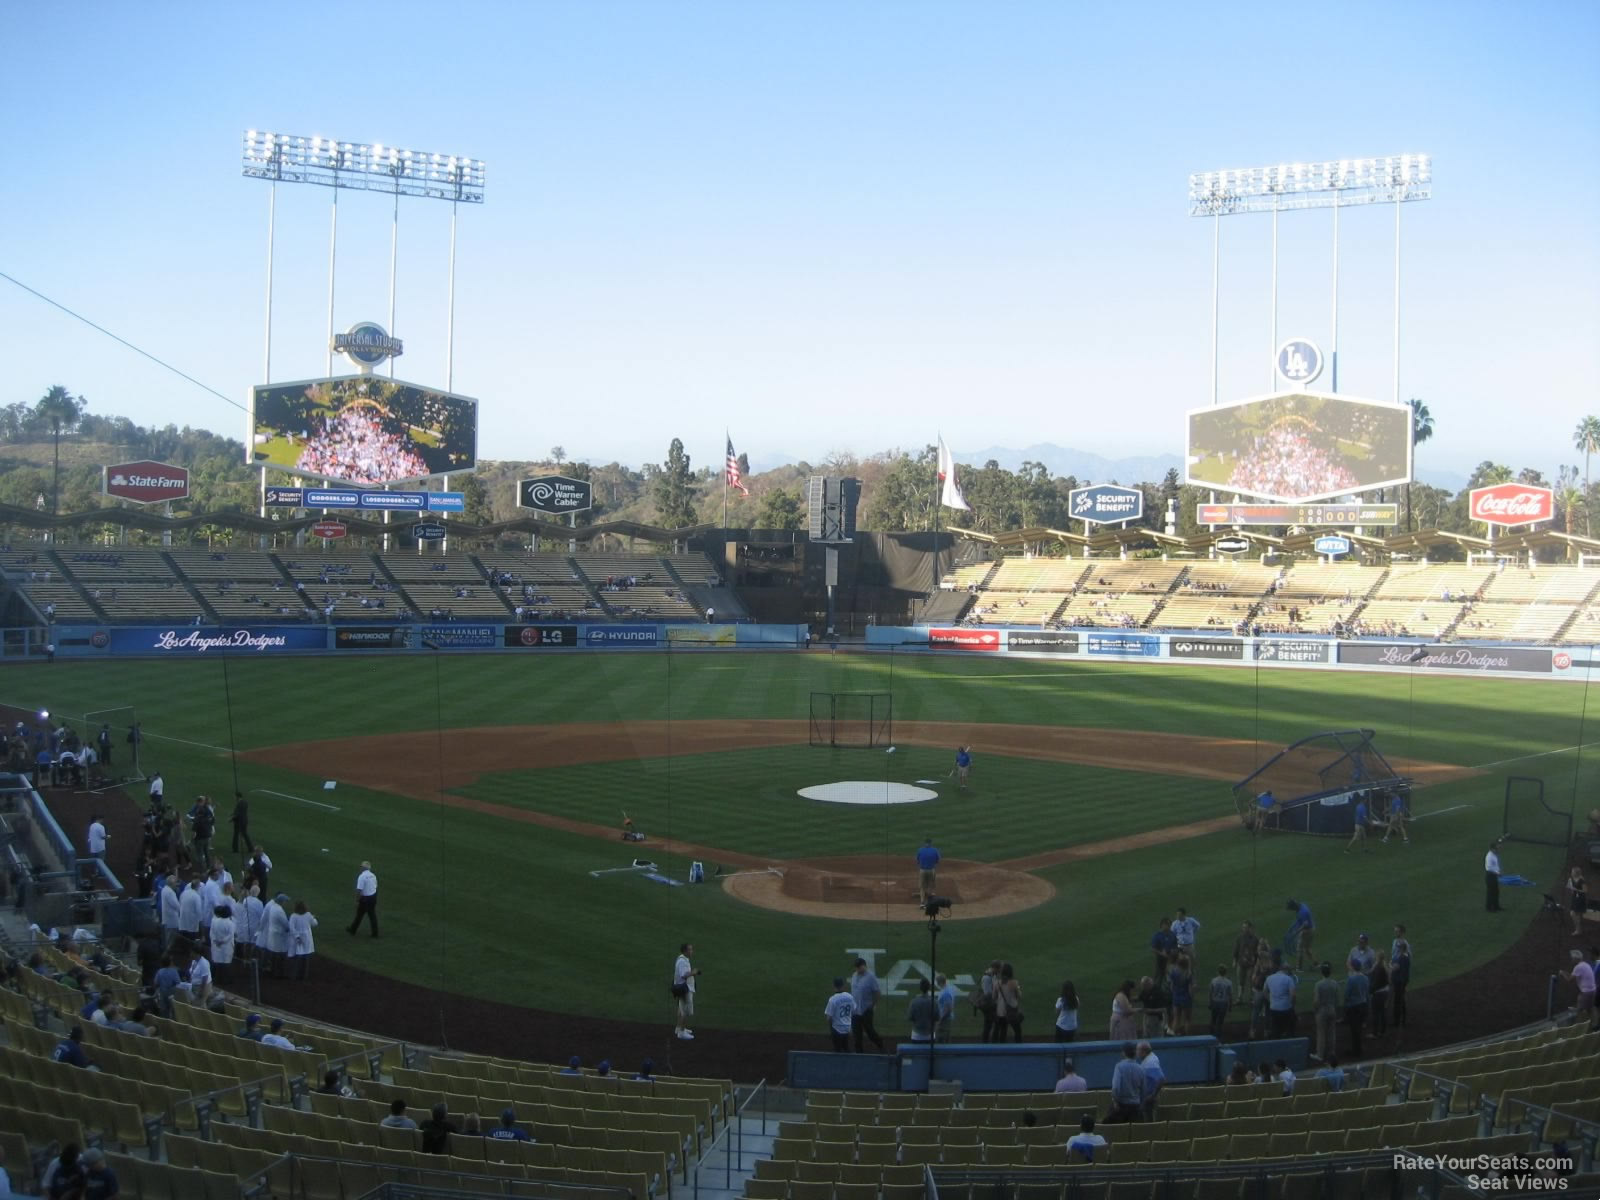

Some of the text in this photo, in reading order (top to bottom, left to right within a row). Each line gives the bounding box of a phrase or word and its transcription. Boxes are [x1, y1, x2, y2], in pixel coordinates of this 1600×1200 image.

[1286, 346, 1308, 377] LA
[129, 475, 185, 488] State Farm
[555, 483, 575, 491] Time
[555, 491, 584, 499] Warner
[1096, 494, 1136, 503] SECURITY
[555, 498, 578, 506] Cable
[1096, 503, 1130, 512] BENEFIT
[1360, 511, 1394, 519] SUBWAY
[155, 630, 286, 651] Los Angeles Dodgers
[542, 630, 563, 643] LG
[608, 632, 656, 640] HYUNDAI
[1194, 644, 1238, 652] INFINITI
[1278, 641, 1324, 651] SECURITY
[1278, 651, 1318, 661] BENEFIT
[1377, 646, 1405, 665] Los
[1453, 649, 1509, 670] Dodgers
[839, 1004, 851, 1018] 28
